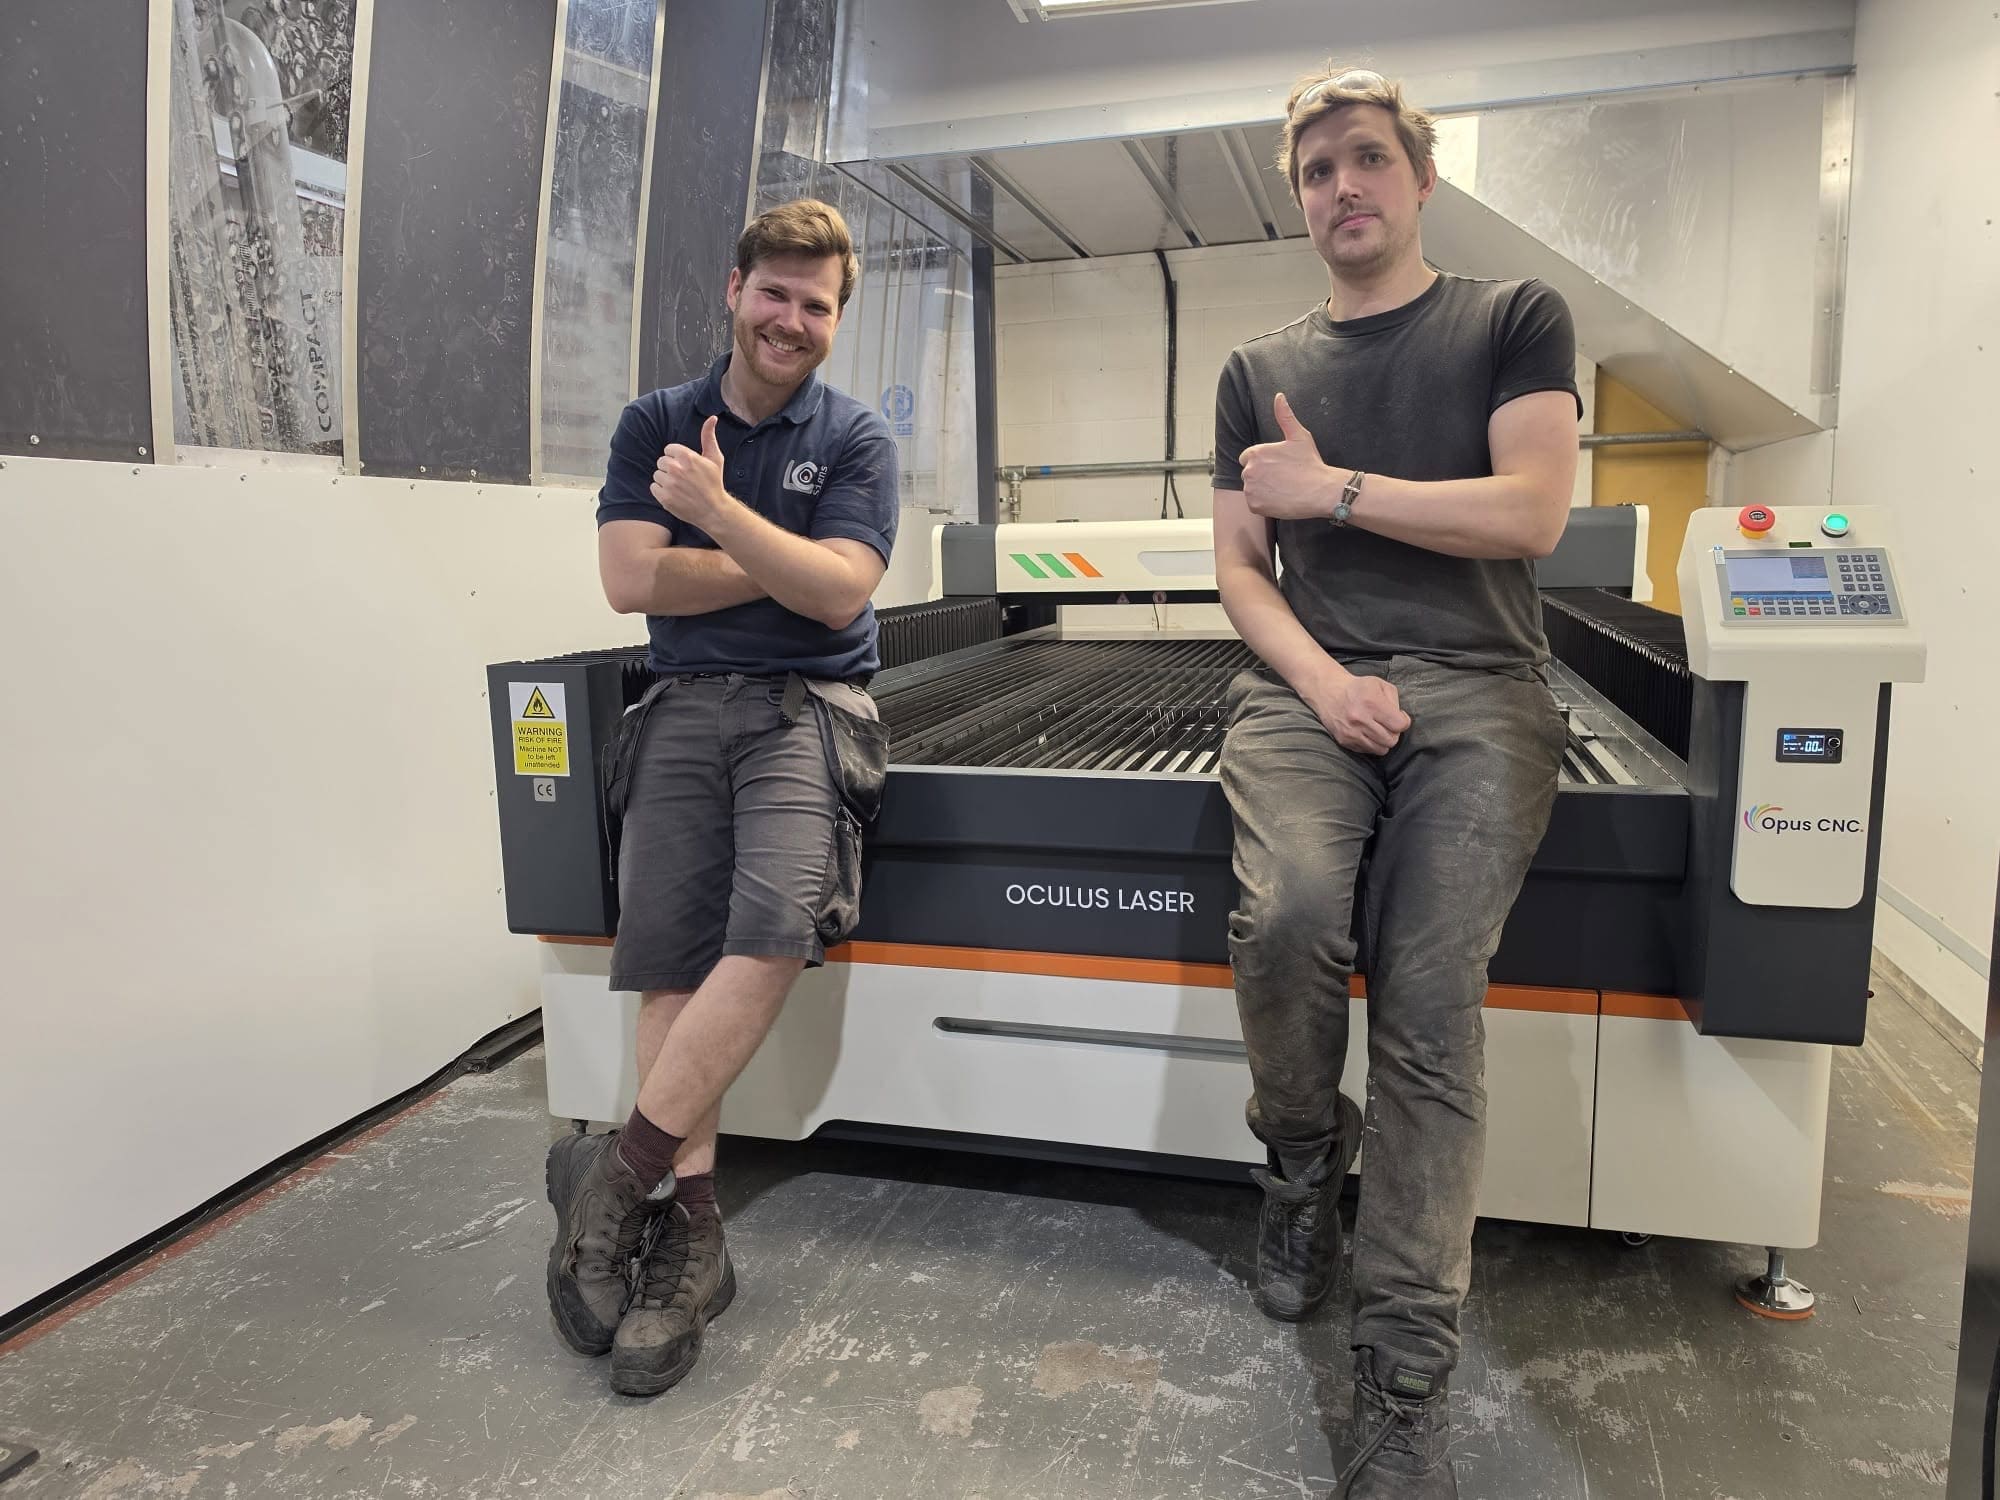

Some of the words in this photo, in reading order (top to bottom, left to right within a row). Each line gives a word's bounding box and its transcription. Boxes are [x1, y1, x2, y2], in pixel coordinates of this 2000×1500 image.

[517, 727, 563, 736] WARNING
[537, 783, 553, 797] CE
[1761, 817, 1812, 834] Opus
[1006, 884, 1110, 909] OCULUS
[1118, 888, 1195, 913] LASER
